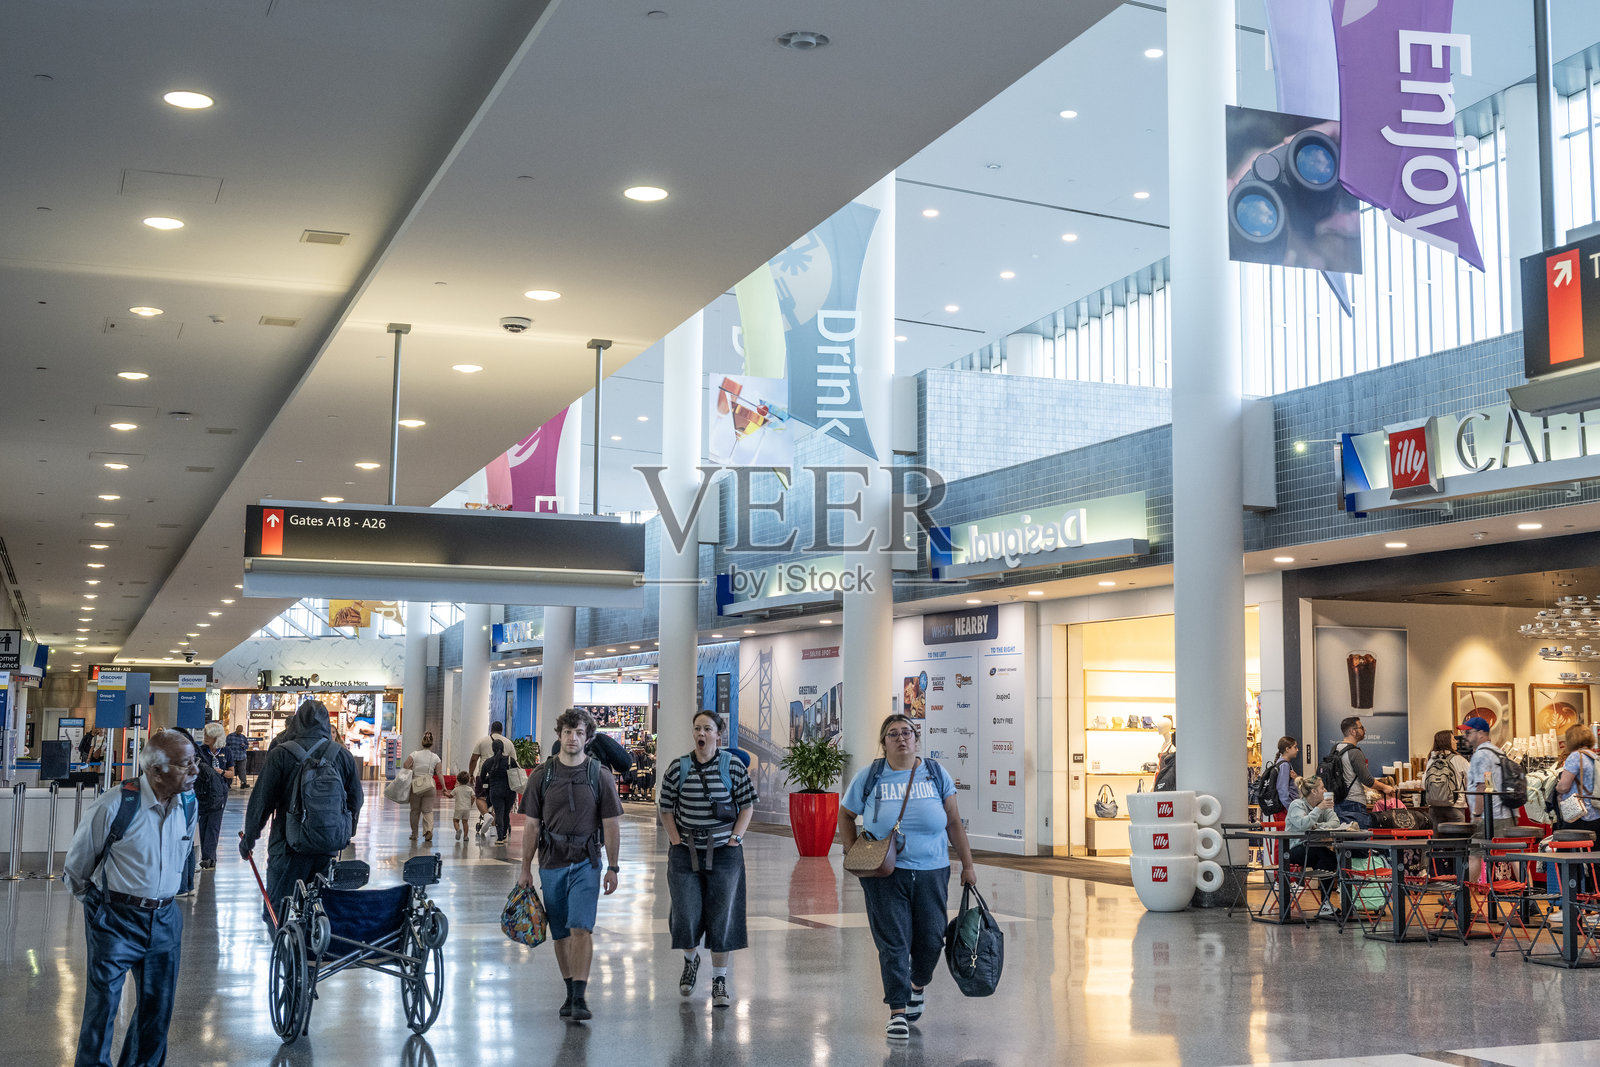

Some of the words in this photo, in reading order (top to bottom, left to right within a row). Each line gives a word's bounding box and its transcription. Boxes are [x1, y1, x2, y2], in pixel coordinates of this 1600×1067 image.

[1381, 29, 1478, 257] Enjoy
[816, 309, 865, 438] Drink
[1394, 439, 1426, 482] illy
[289, 514, 323, 526] Gates
[326, 516, 351, 528] A18
[361, 518, 386, 529] A26
[931, 624, 954, 639] WHAT'S
[954, 614, 989, 636] NEARBY
[996, 717, 1005, 725] DUTY
[1005, 717, 1014, 725] FREE
[874, 781, 935, 800] HAMPION
[1158, 803, 1173, 816] illy
[1154, 835, 1168, 848] illy
[1152, 868, 1167, 881] illy
